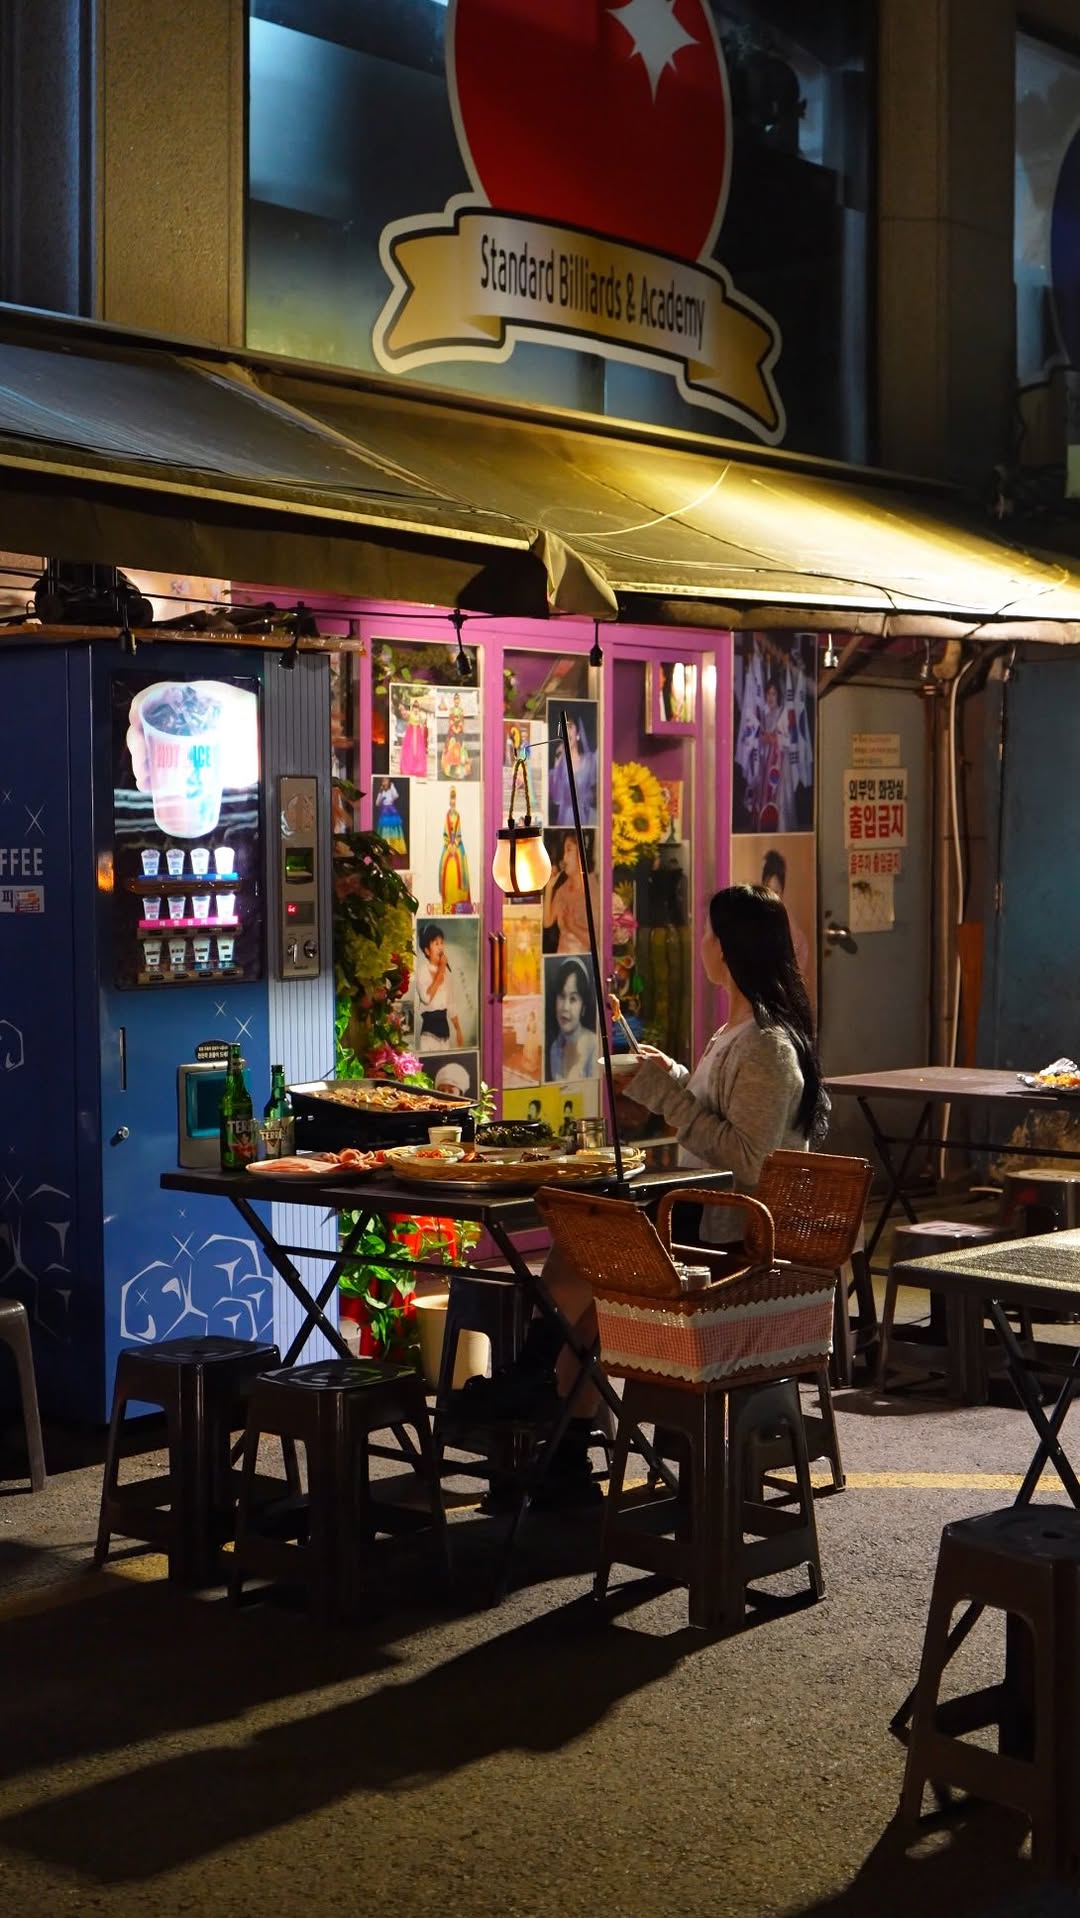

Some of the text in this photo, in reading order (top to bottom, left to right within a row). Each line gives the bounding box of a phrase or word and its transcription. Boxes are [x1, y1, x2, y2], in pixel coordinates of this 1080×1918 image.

[480, 233, 706, 351] Standard Billiards & Academy
[156, 744, 211, 769] HOT ICE
[849, 779, 904, 801] 외부인 화장실
[849, 804, 904, 840] 출입금지
